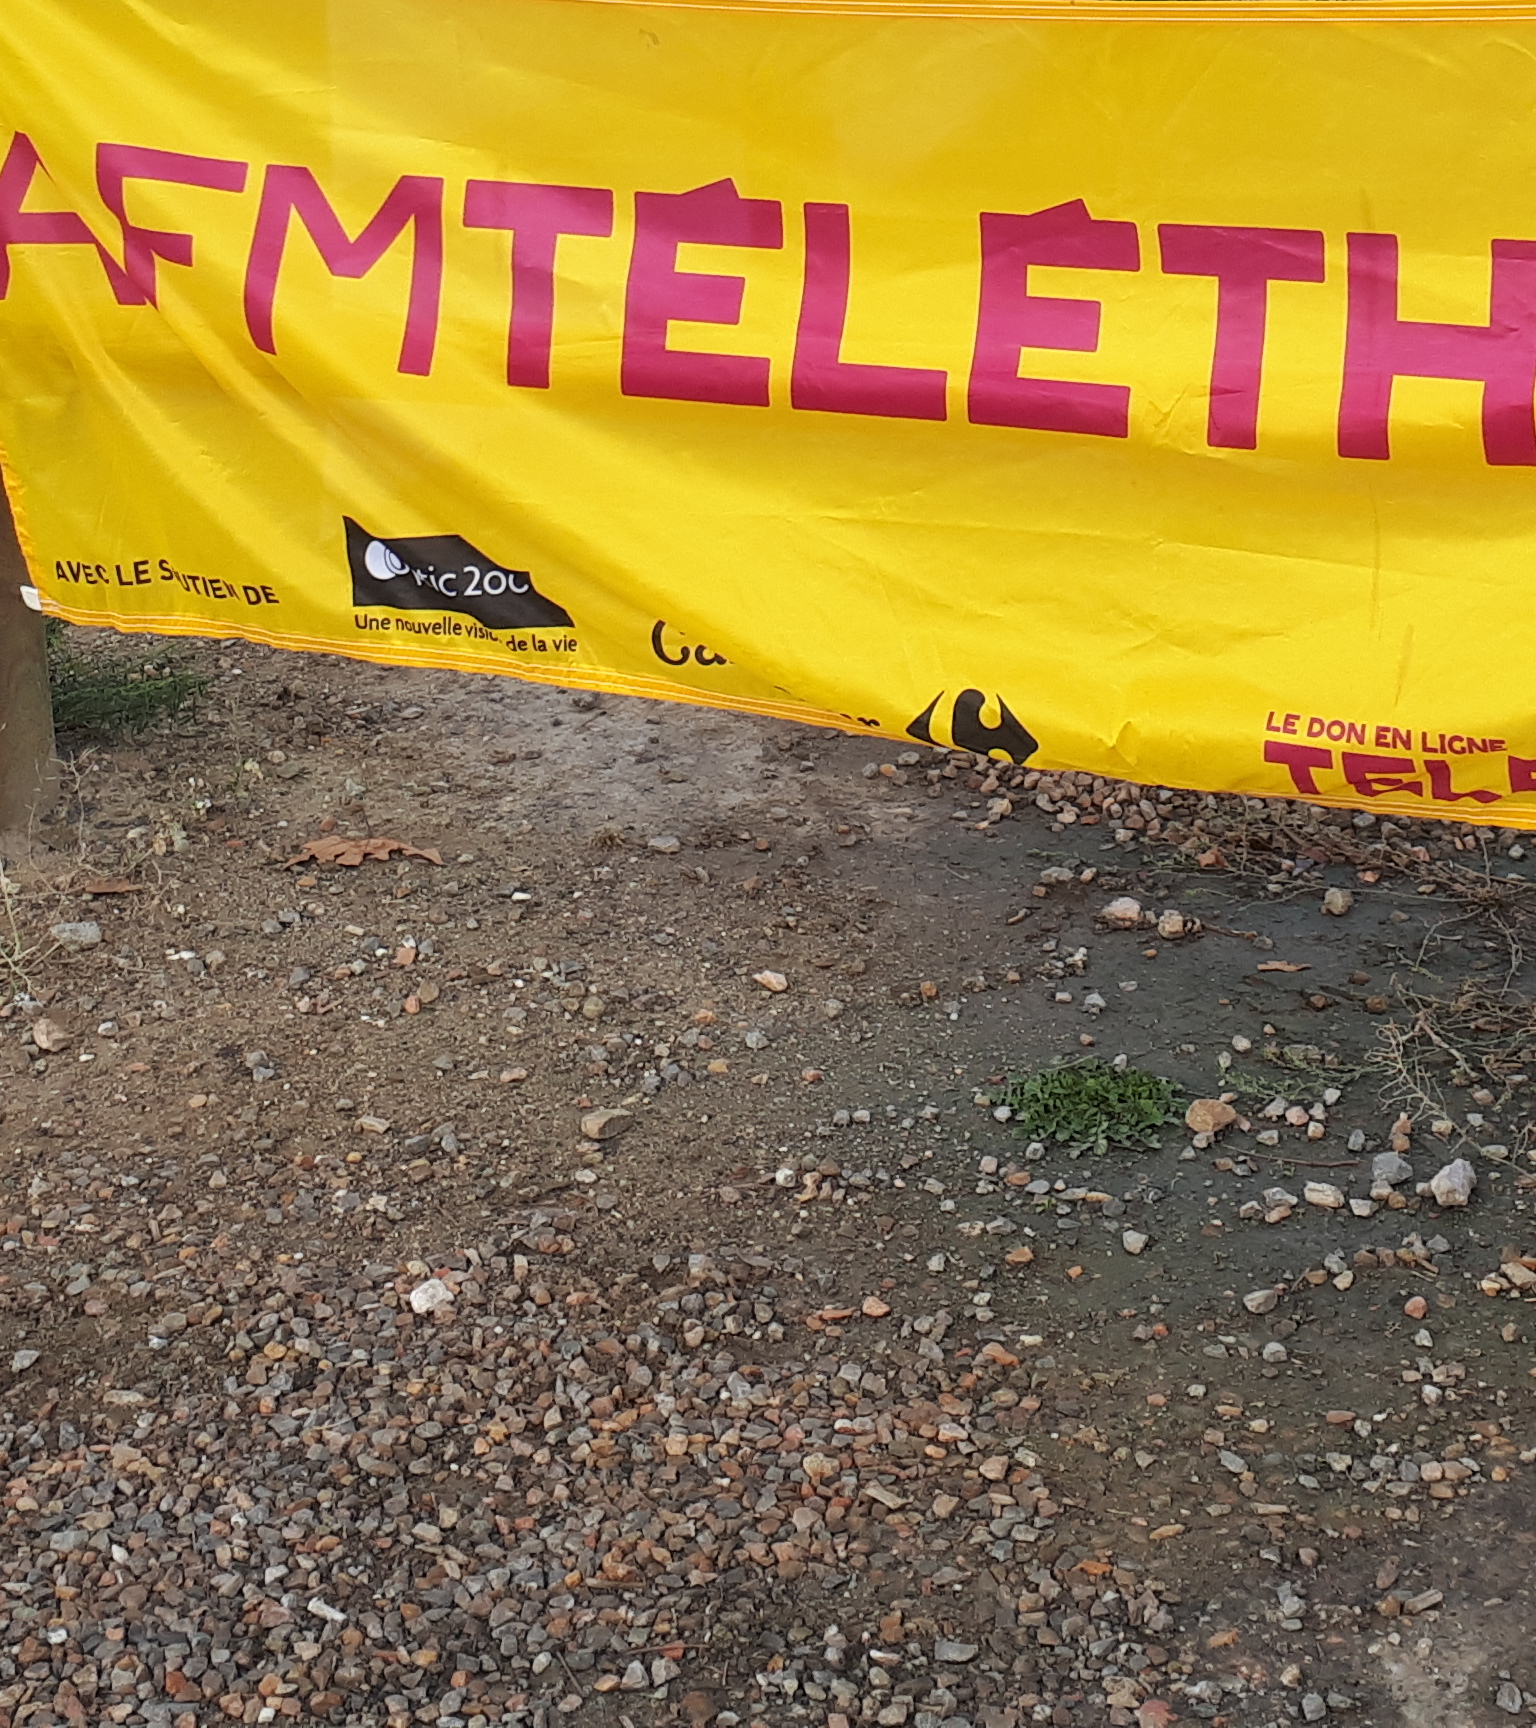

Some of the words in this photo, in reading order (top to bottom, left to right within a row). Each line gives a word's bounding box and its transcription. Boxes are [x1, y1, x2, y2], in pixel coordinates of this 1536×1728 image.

[56, 560, 110, 585] AVEC
[115, 559, 152, 586] LE
[158, 558, 241, 601] SUTIEN
[242, 585, 280, 606] DE
[354, 614, 391, 631] Une
[395, 615, 462, 636] nouvelle
[506, 634, 527, 652] de
[532, 634, 548, 652] la
[552, 635, 578, 652] vie
[1265, 711, 1301, 735] LE
[1306, 716, 1367, 746] DON
[1375, 725, 1412, 751] EN
[1421, 731, 1507, 755] LIGNE
